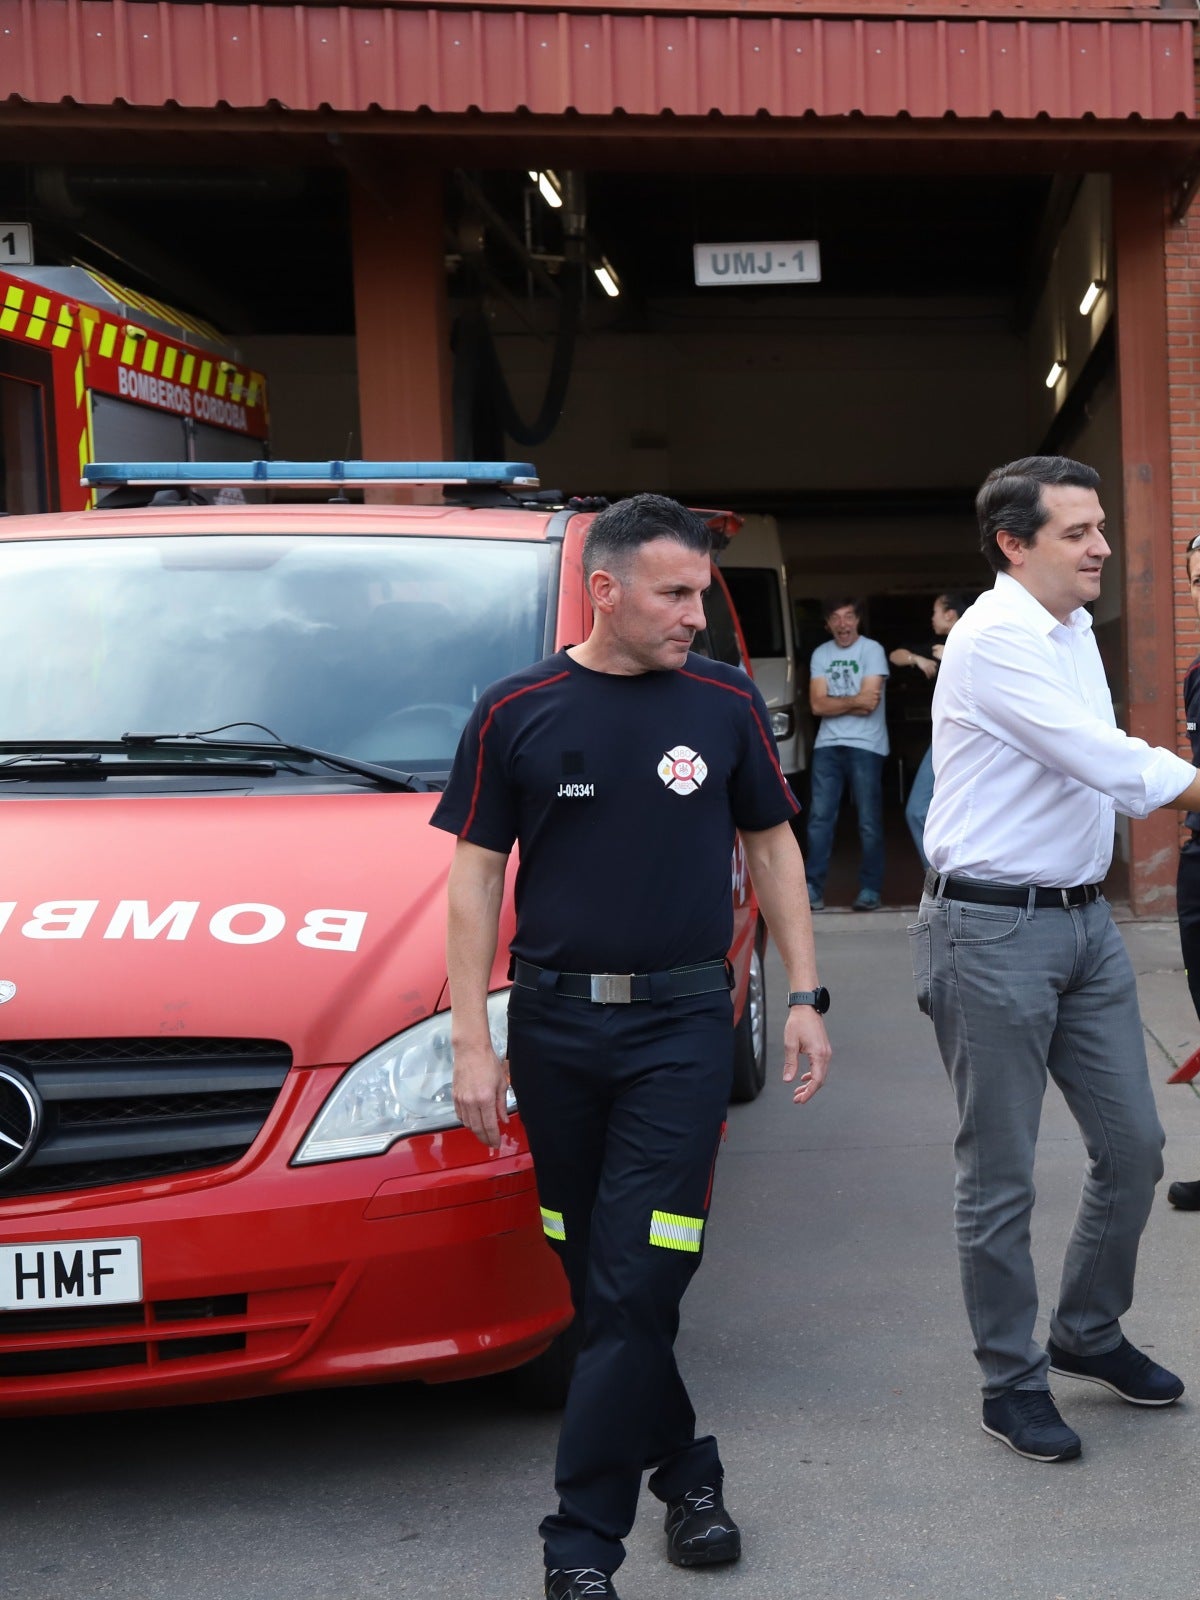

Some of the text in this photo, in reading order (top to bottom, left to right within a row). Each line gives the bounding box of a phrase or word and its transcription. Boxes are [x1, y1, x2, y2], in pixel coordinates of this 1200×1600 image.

[2, 232, 16, 256] 1
[118, 366, 192, 415] BOMBEROS
[557, 783, 595, 797] J-0/3341
[15, 1248, 122, 1300] HMF
